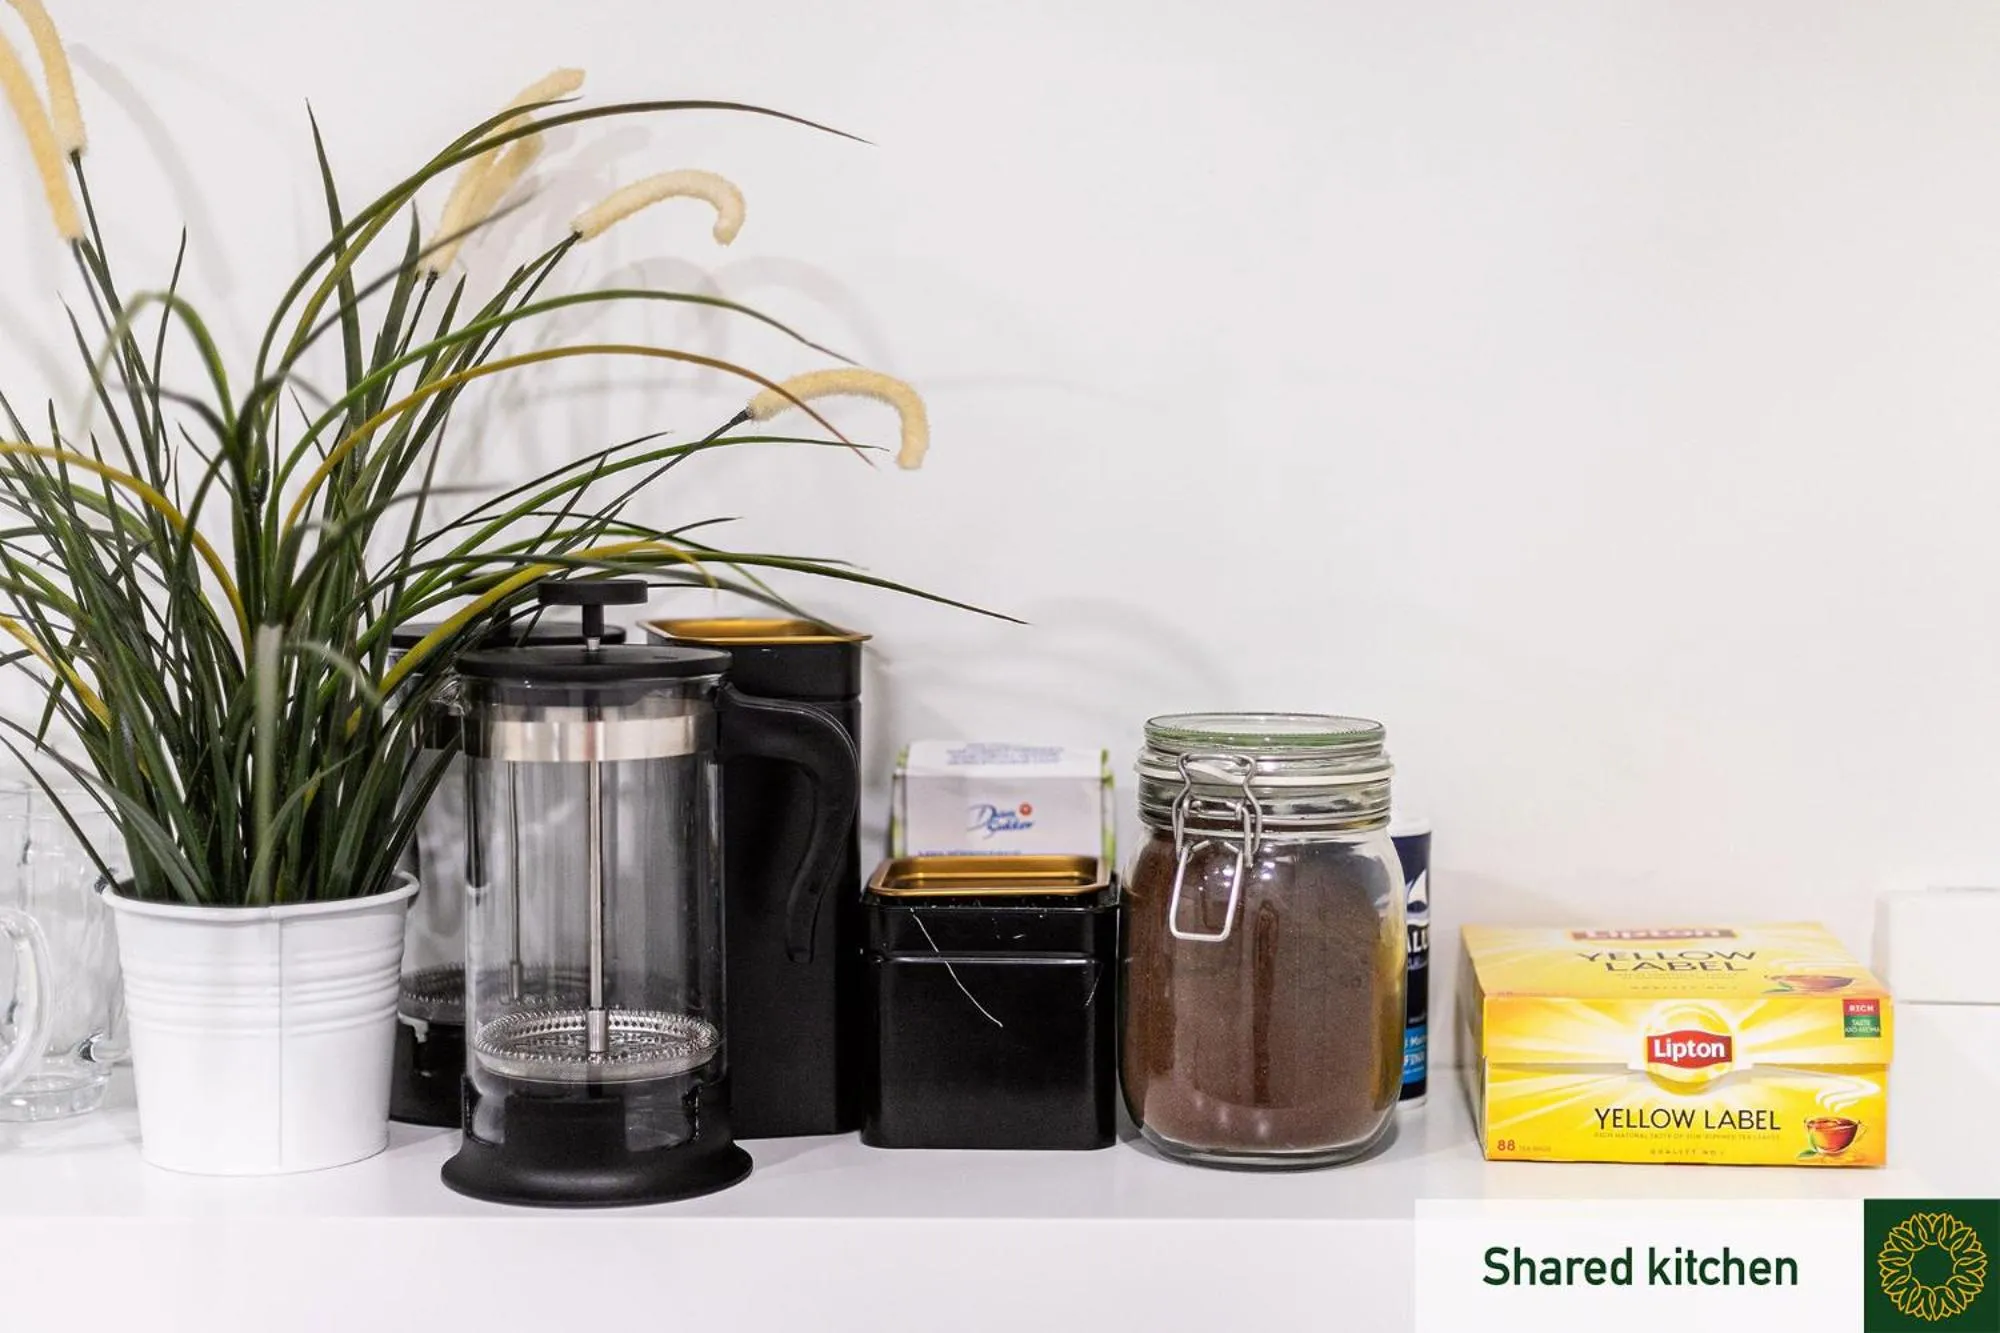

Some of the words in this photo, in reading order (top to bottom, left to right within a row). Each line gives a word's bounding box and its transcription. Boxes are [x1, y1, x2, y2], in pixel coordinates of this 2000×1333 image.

[1577, 951, 1757, 962] YELLOW
[1605, 962, 1749, 972] LABEL
[1654, 1038, 1726, 1062] Lipton
[1595, 1108, 1695, 1130] YELLOW
[1705, 1110, 1781, 1130] LABEL
[1497, 1139, 1516, 1151] 88
